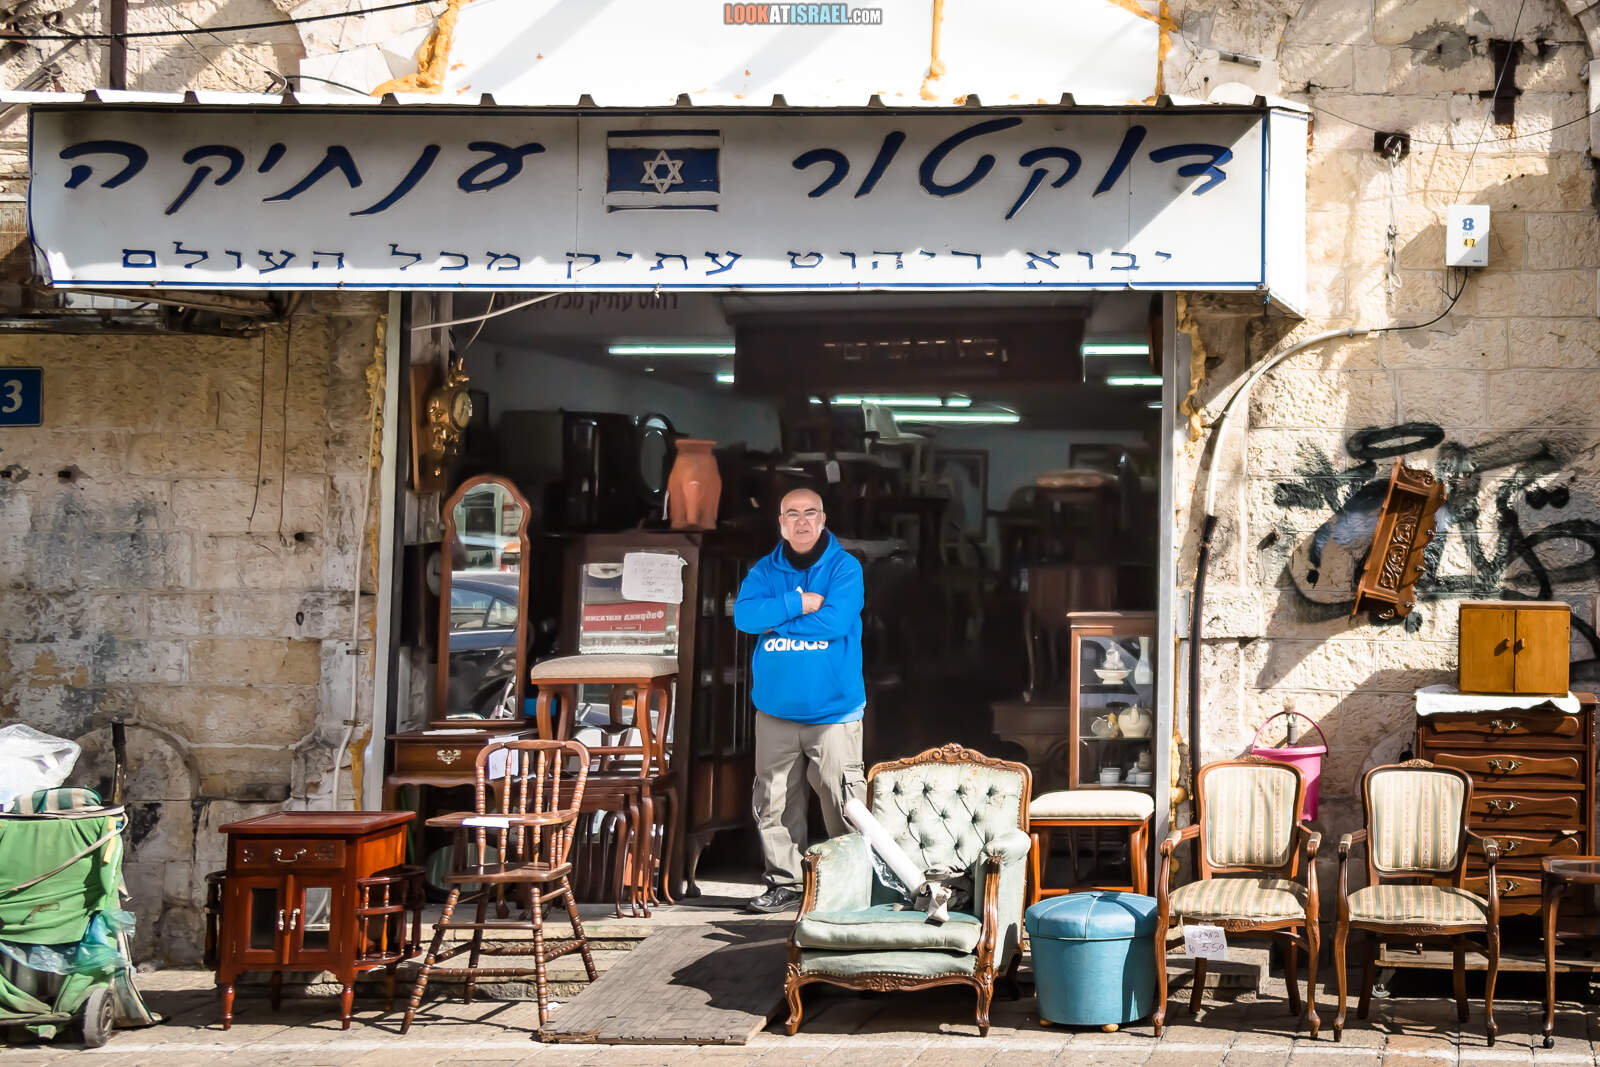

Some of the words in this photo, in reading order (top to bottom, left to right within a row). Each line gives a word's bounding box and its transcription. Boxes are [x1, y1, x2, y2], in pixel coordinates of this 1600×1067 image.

[59, 140, 547, 216] ענתיקה
[792, 116, 1234, 220] דוקטור
[121, 240, 347, 276] העולם
[388, 242, 522, 273] מכל
[565, 250, 742, 280] עתיק
[787, 249, 983, 271] ריהוט
[1024, 249, 1173, 272] יבוא
[2, 379, 23, 413] 3
